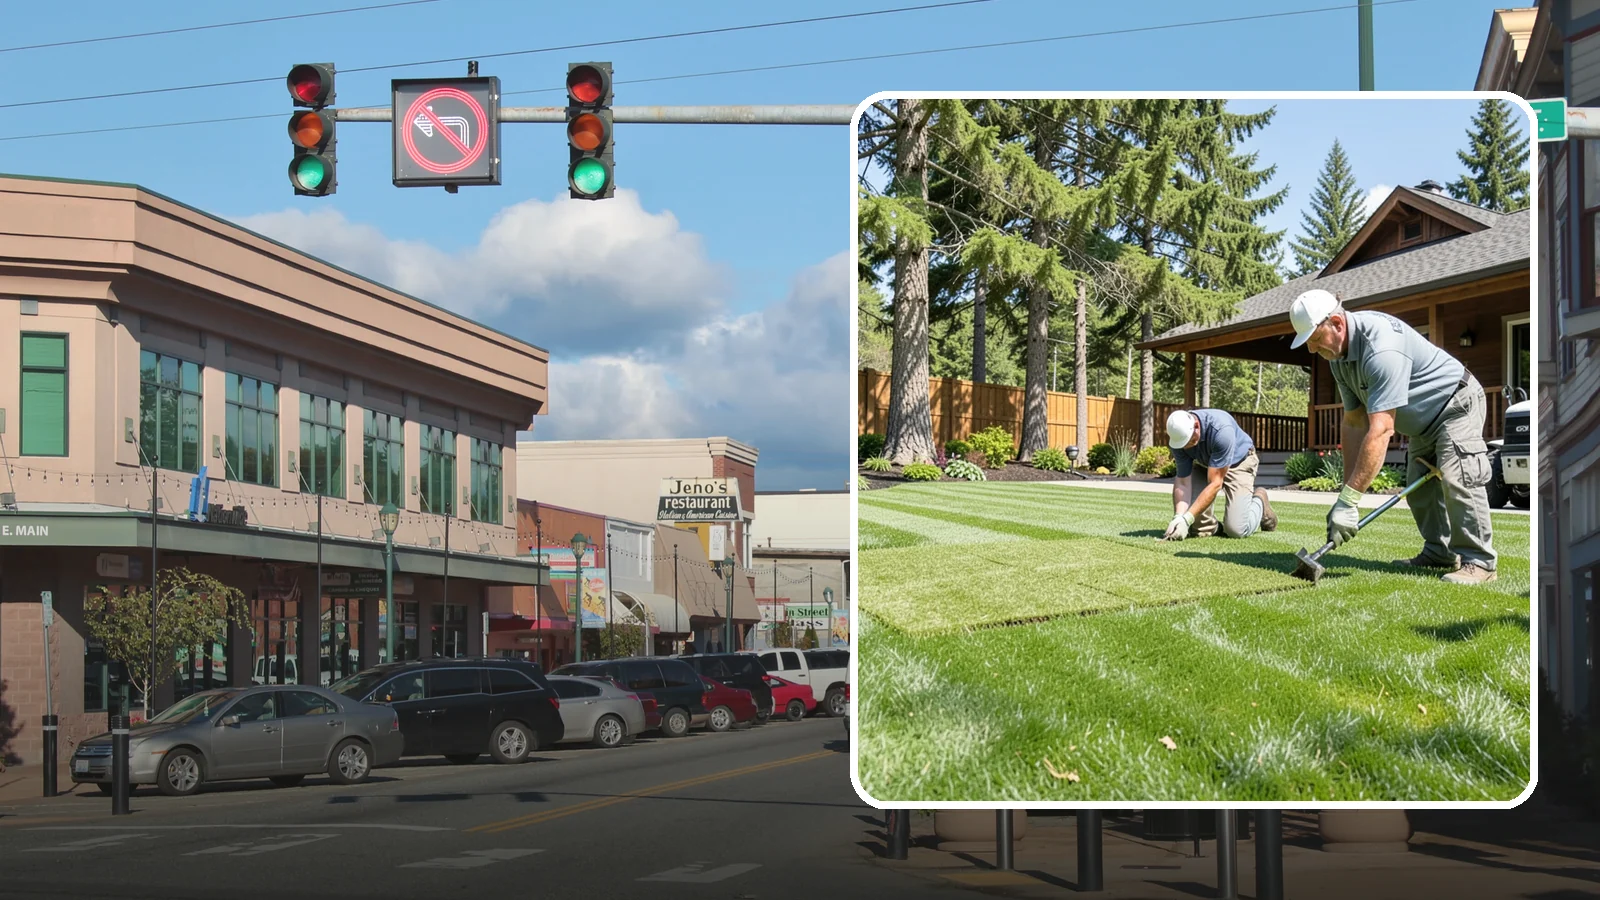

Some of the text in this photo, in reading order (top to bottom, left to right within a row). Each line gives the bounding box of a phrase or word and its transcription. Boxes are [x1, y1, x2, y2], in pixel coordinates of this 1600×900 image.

[670, 480, 727, 495] Jeno's
[665, 496, 731, 509] restaurant
[658, 509, 681, 520] Italian
[686, 509, 715, 519] American
[715, 509, 738, 519] Cuisine
[2, 525, 49, 536] E. MAIN
[797, 607, 829, 617] Street
